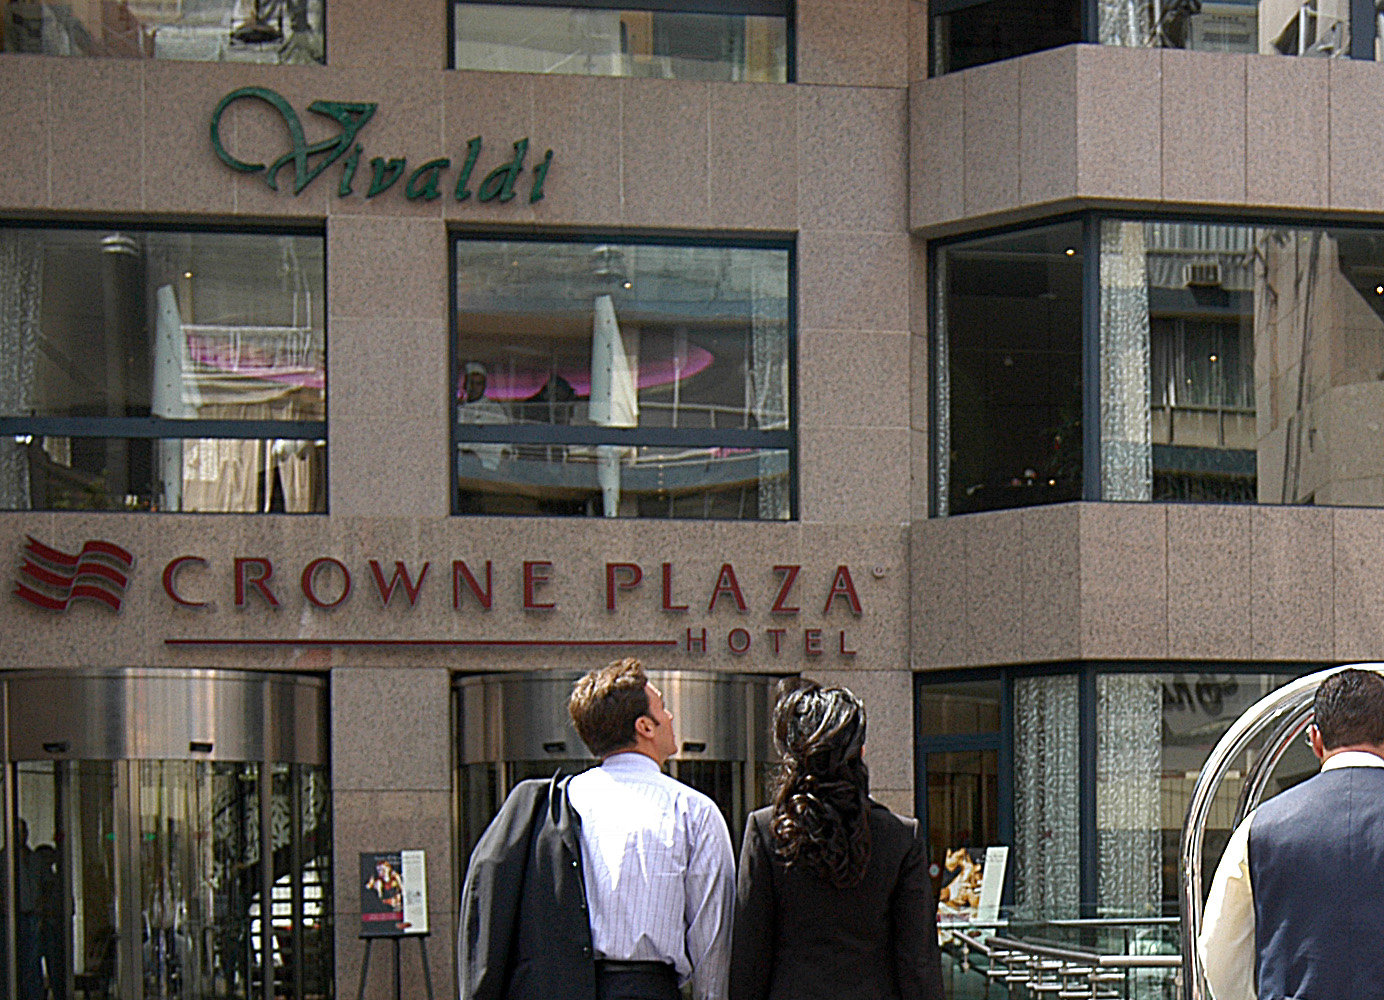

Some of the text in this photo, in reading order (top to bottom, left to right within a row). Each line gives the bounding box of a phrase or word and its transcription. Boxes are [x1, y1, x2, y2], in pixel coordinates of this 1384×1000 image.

[210, 86, 553, 204] Vivaldi
[162, 555, 862, 614] CROWNE PLAZA
[686, 627, 857, 656] HOTEL
